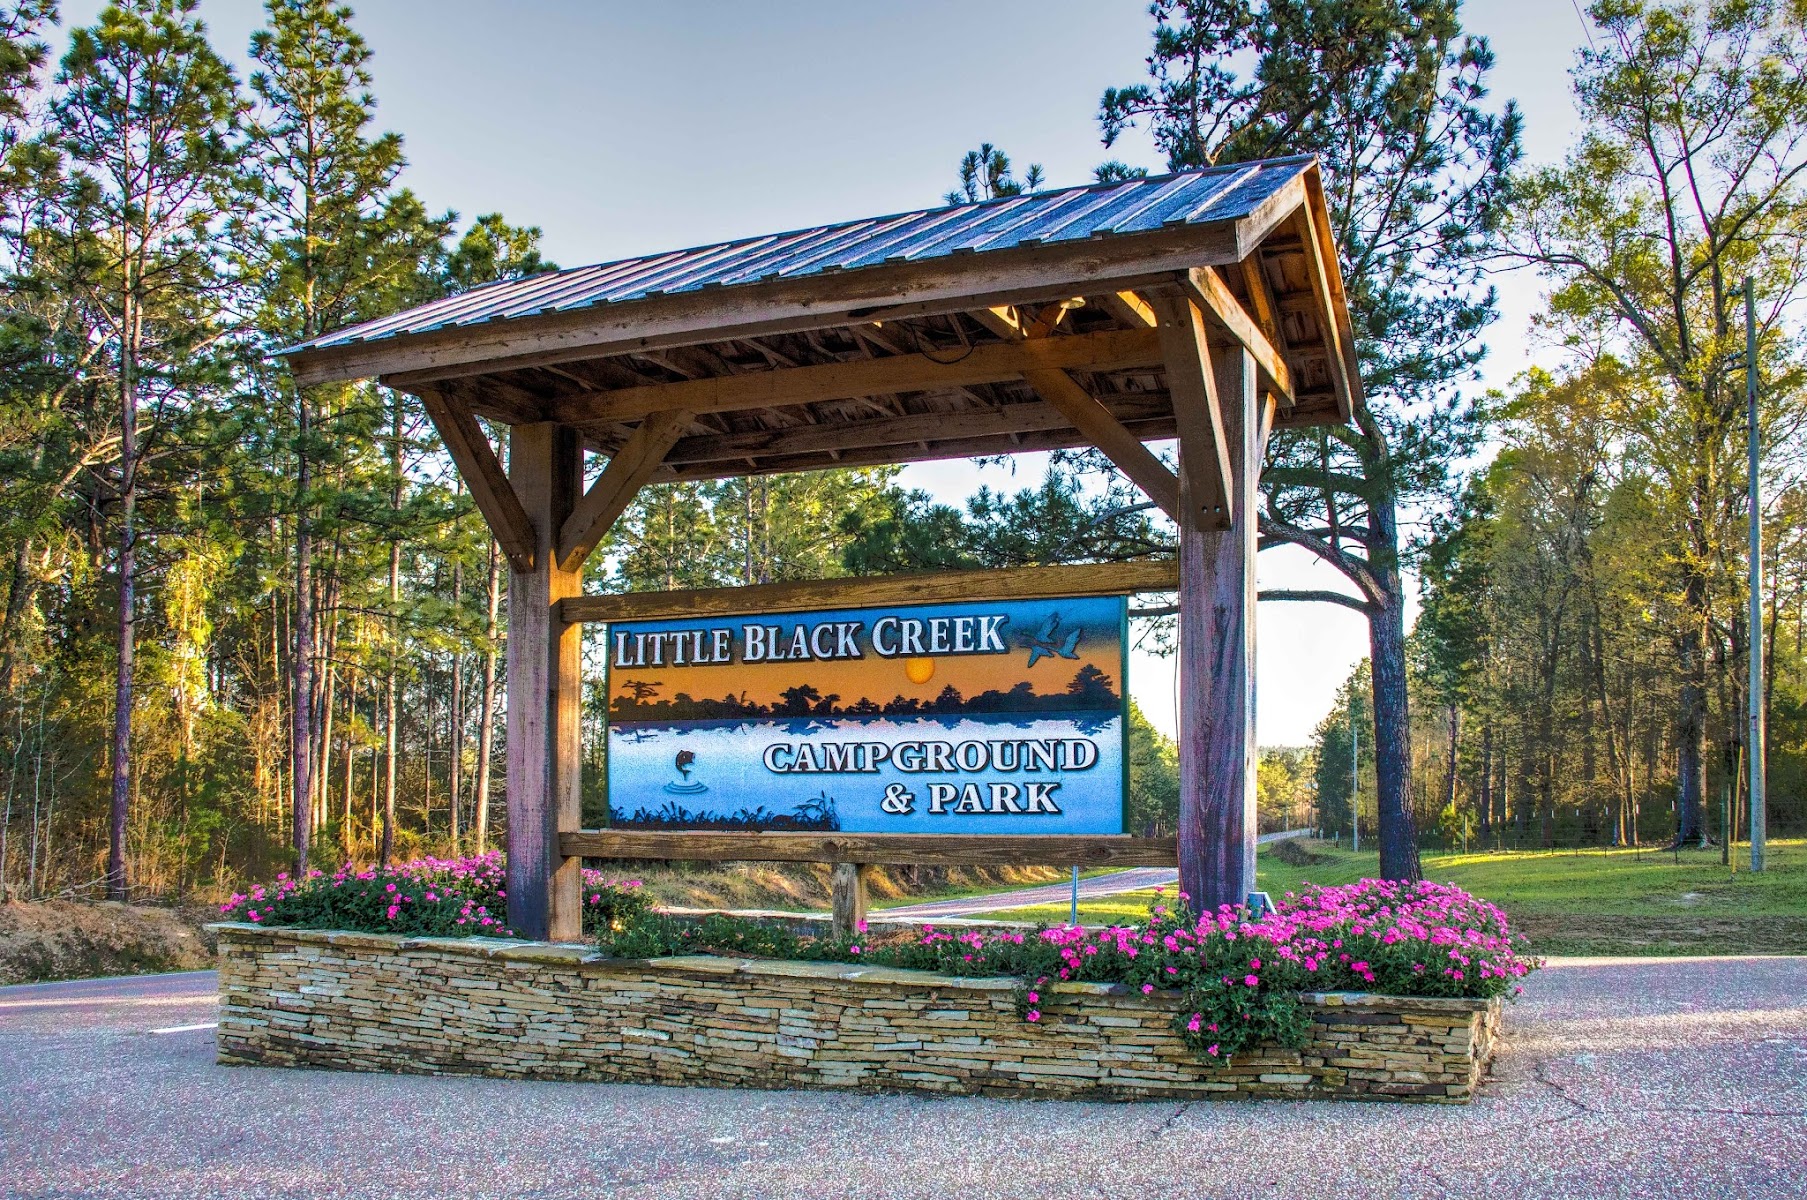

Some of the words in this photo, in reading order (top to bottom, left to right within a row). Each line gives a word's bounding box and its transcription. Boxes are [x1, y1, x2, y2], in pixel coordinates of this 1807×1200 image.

[614, 629, 732, 669] LITTLE
[742, 621, 865, 663] BLACK
[872, 615, 1008, 658] CREEK
[763, 739, 1099, 773] CAMPGROUND
[881, 783, 914, 815] &
[929, 782, 1062, 815] PARK
